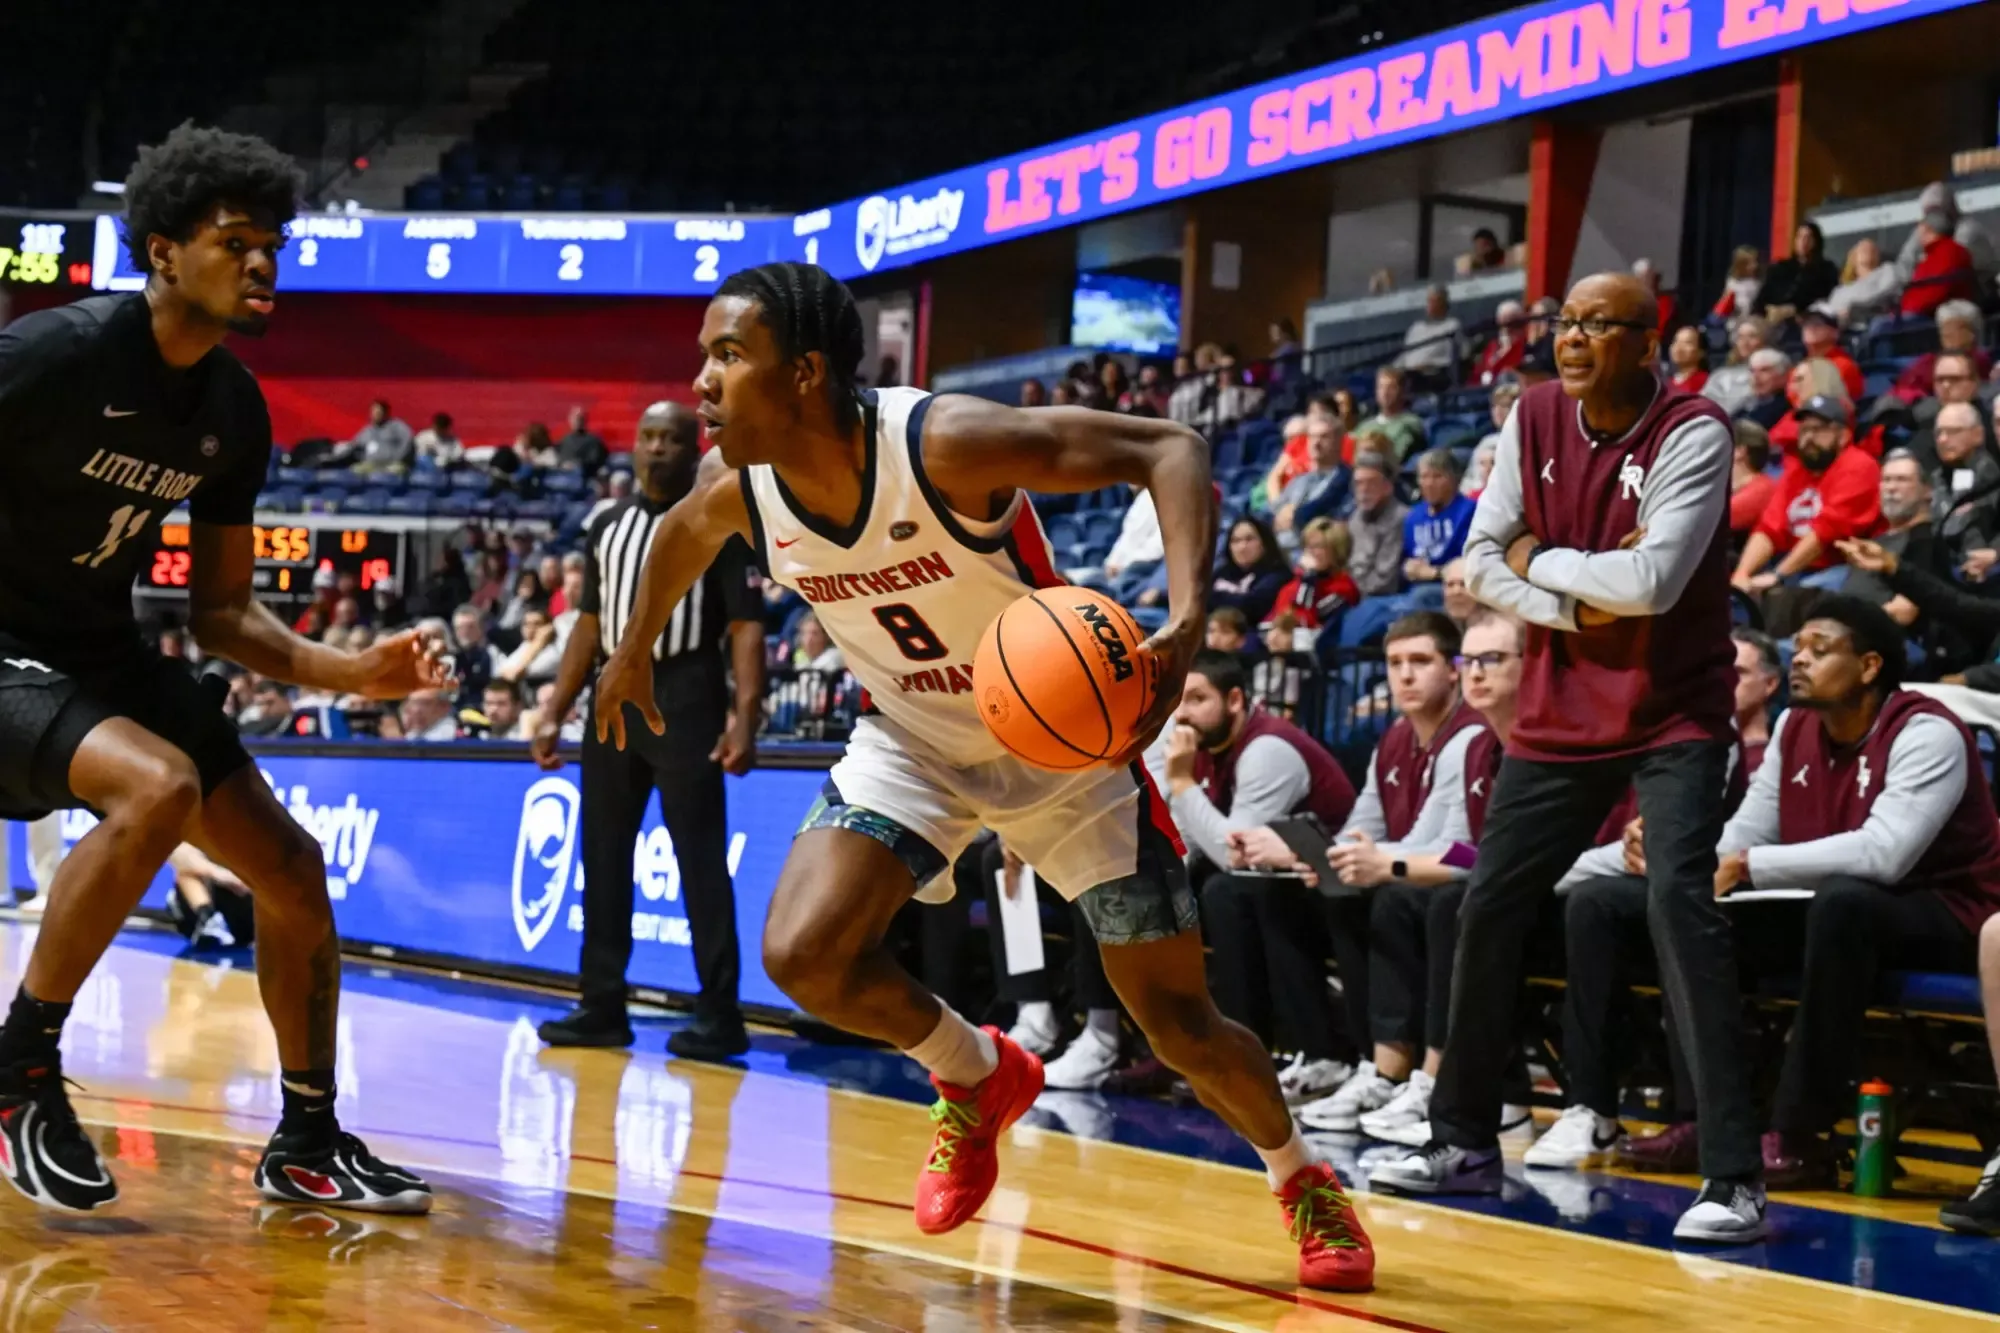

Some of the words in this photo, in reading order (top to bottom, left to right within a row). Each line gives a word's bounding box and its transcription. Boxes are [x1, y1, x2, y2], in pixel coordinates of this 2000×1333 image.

[984, 131, 1141, 234] LET'S
[1152, 107, 1232, 189] GO
[1247, 0, 1692, 167] SCREAMING
[298, 238, 319, 266] 2
[427, 242, 451, 280] 5
[558, 244, 584, 281] 2
[693, 245, 720, 282] 2
[80, 448, 160, 492] LITTLE
[152, 551, 191, 585] 22
[795, 551, 955, 603] SOUTHERN
[871, 602, 949, 661] 8
[1073, 603, 1134, 684] NCAA
[1859, 1111, 1881, 1138] G
